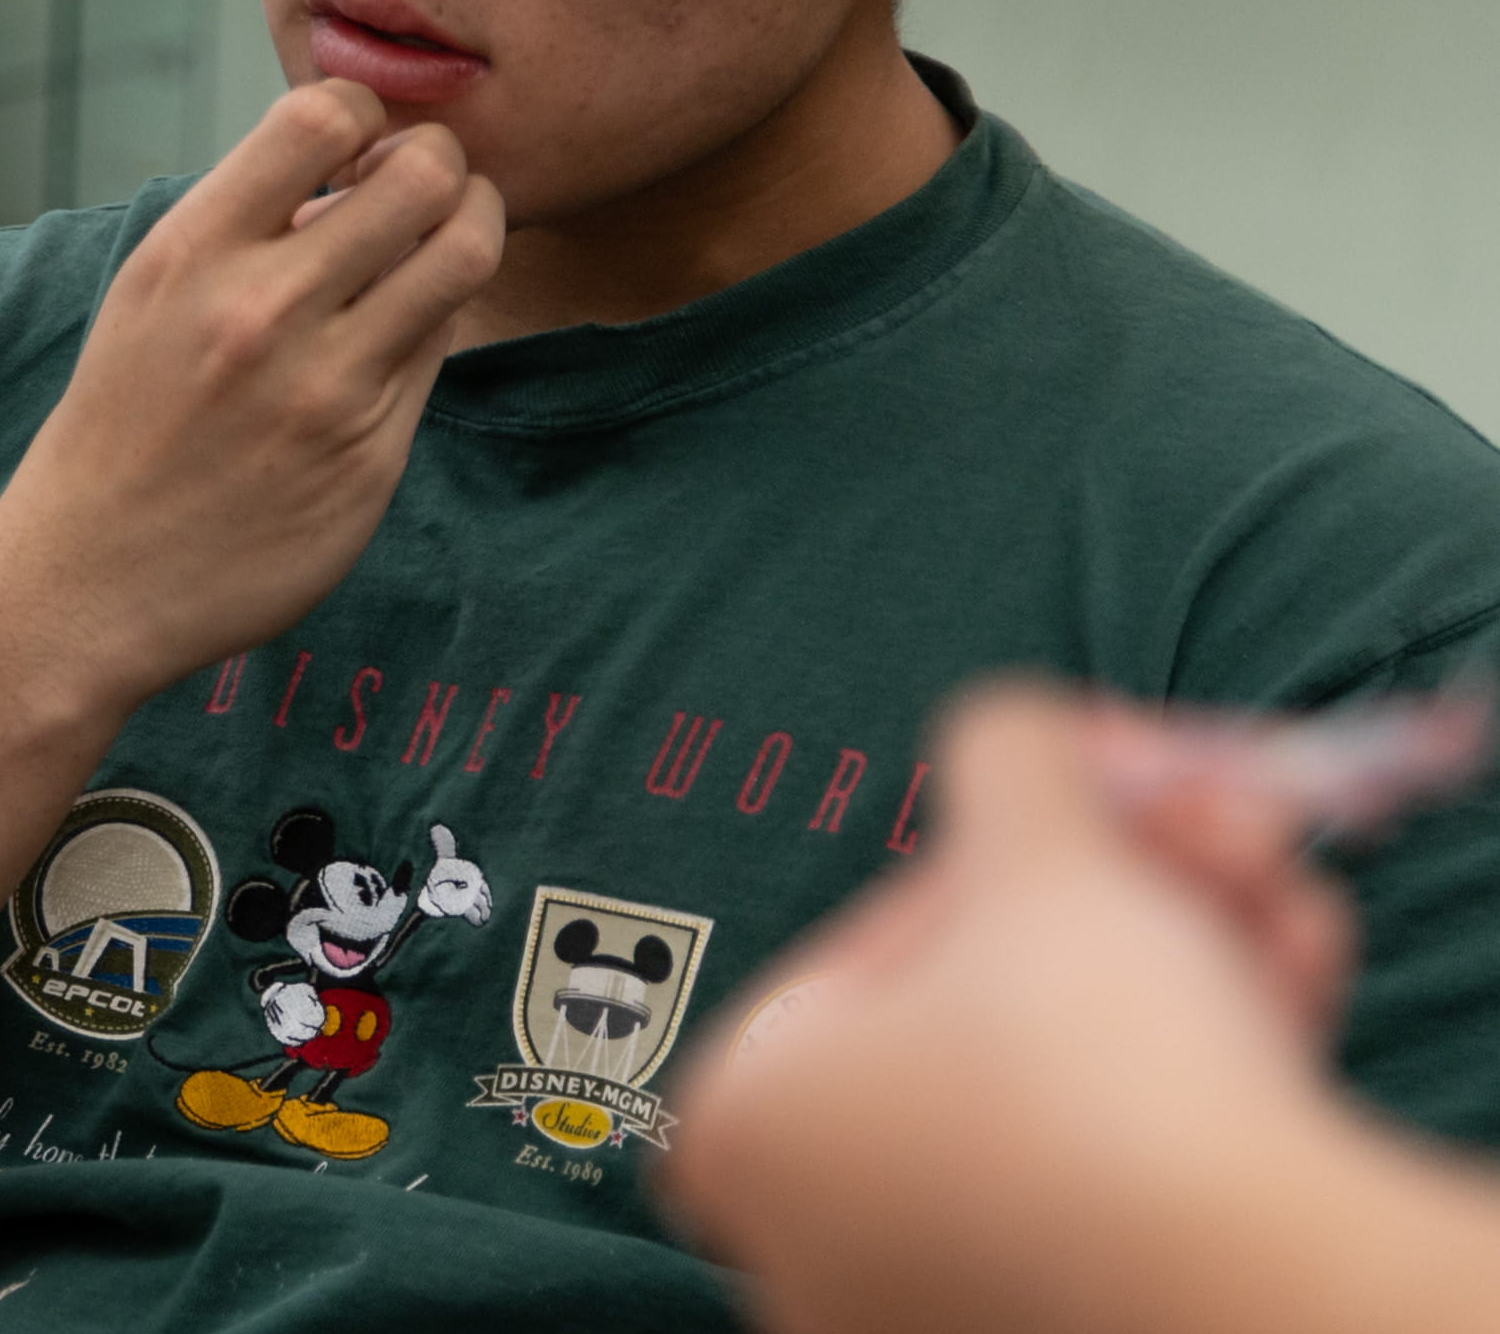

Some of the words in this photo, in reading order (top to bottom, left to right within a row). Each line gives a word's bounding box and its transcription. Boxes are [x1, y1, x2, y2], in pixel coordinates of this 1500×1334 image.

[204, 651, 582, 781] DISNEY
[645, 711, 932, 856] WORL
[27, 1028, 71, 1059] Est.
[82, 1049, 129, 1074] 1982
[500, 1071, 655, 1122] DISNEY-MGM
[541, 1101, 602, 1141] Studios
[514, 1143, 556, 1173] Est.
[561, 1157, 603, 1186] 1989
